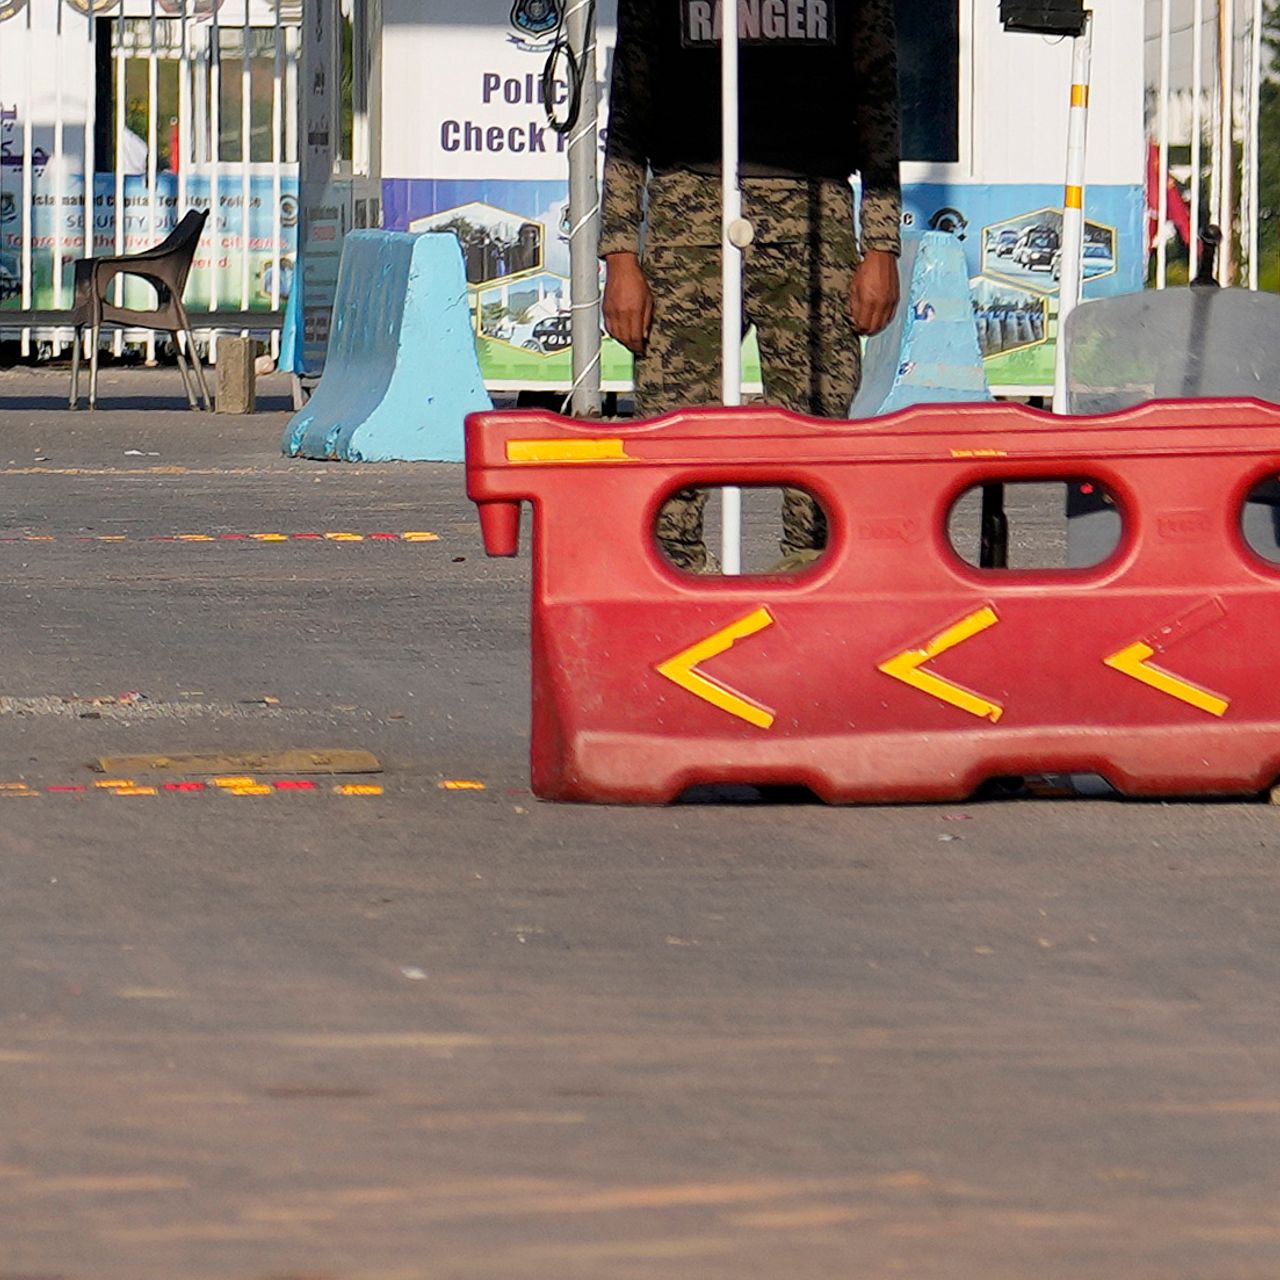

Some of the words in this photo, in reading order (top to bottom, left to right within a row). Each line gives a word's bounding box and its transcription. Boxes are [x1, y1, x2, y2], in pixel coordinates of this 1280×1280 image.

[482, 73, 569, 105] Polic
[441, 120, 546, 153] Check
[540, 334, 572, 345] POLI
